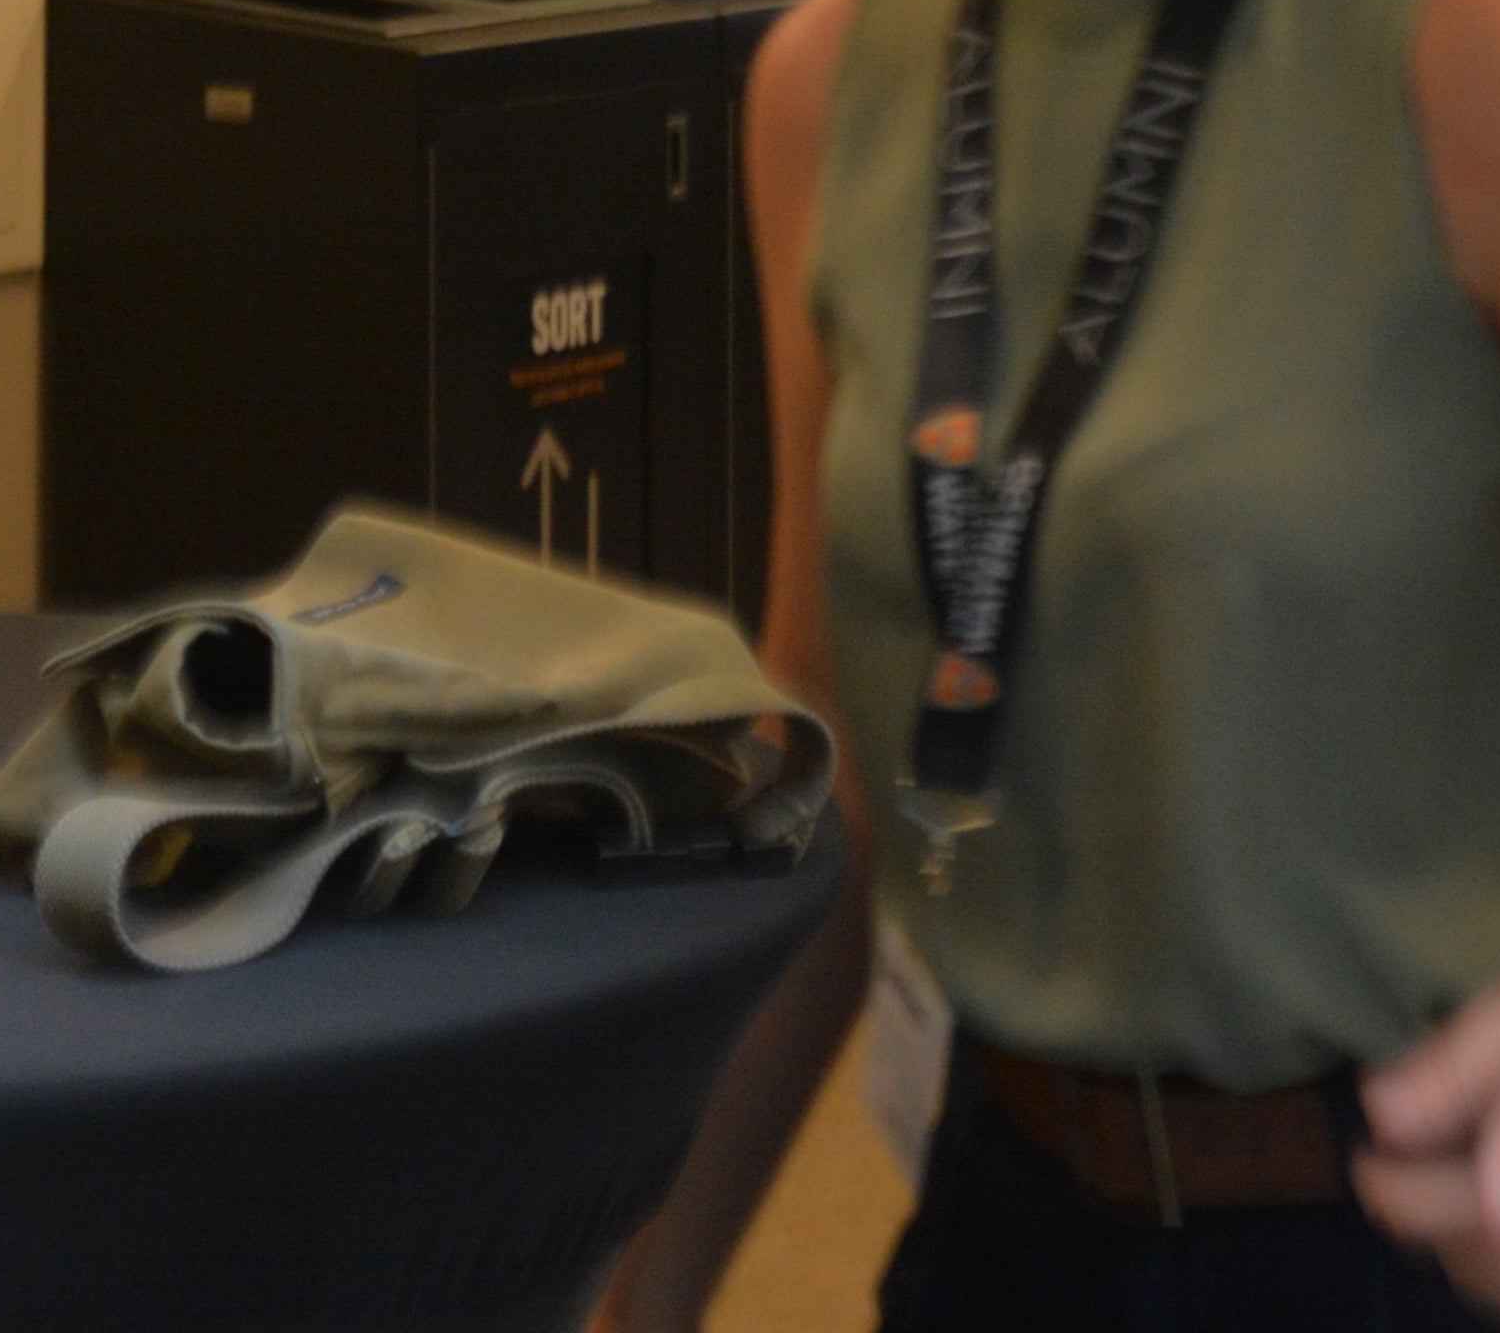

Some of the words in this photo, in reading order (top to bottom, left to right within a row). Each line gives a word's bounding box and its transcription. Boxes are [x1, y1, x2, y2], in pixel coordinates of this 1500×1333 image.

[530, 279, 606, 357] SORT
[929, 30, 993, 319] ALUMNI
[1057, 59, 1202, 364] ALUMNI
